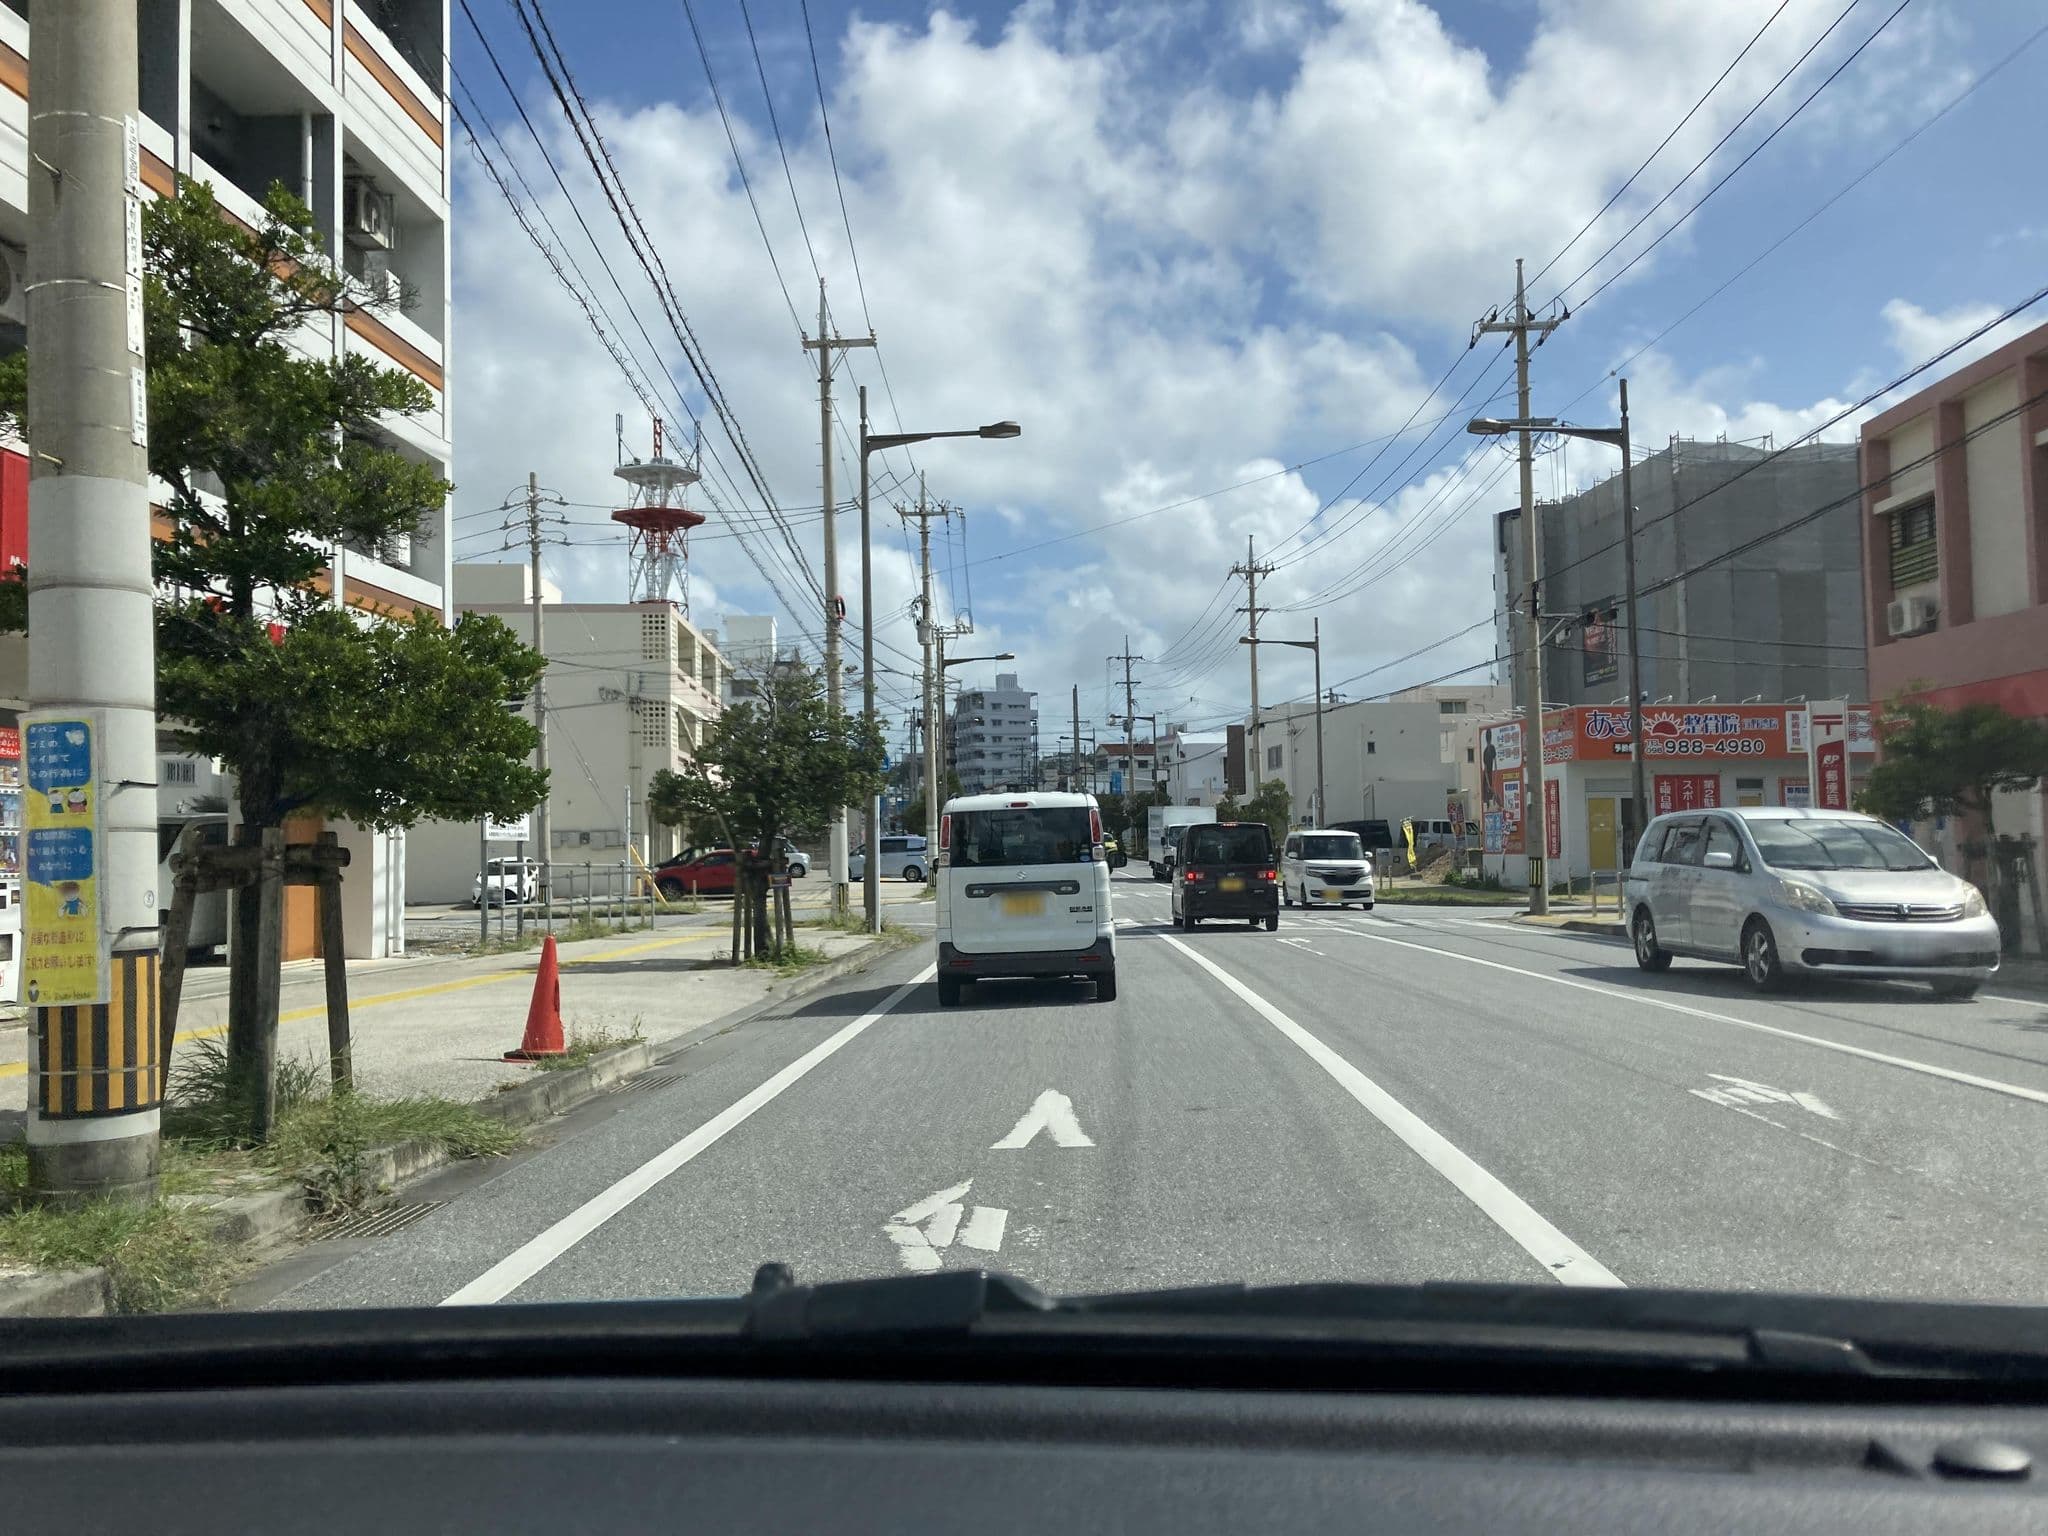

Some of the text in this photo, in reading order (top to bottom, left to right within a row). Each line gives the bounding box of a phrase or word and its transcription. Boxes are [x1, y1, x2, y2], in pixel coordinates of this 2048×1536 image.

[1684, 714, 1740, 734] 整骨院
[1665, 740, 1765, 754] 988-4980
[1825, 770, 1840, 806] 郵便局
